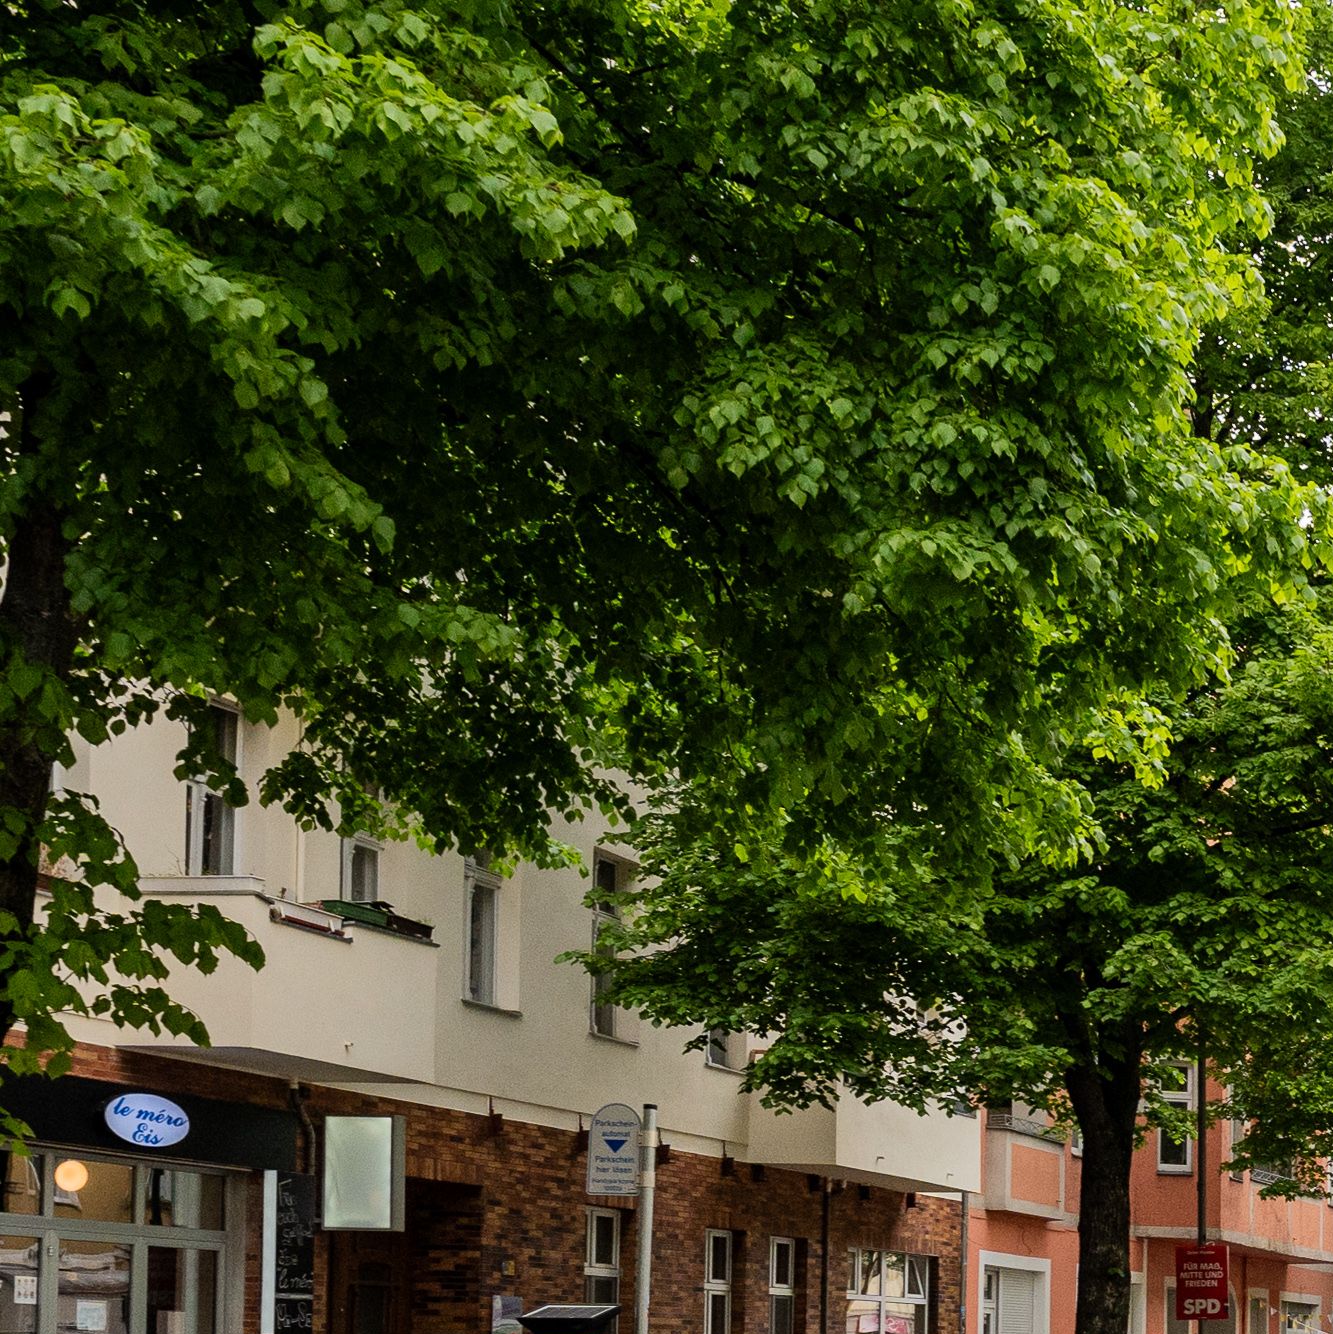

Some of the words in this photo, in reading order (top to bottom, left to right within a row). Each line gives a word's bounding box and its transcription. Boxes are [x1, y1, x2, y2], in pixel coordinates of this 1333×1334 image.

[113, 1097, 134, 1116] le
[136, 1109, 187, 1127] méro
[132, 1122, 164, 1145] Eis
[1183, 1262, 1198, 1270] FÜR
[1180, 1271, 1203, 1279] MITTE
[1185, 1280, 1218, 1288] FRIEDEN
[1183, 1298, 1221, 1315] SPD
